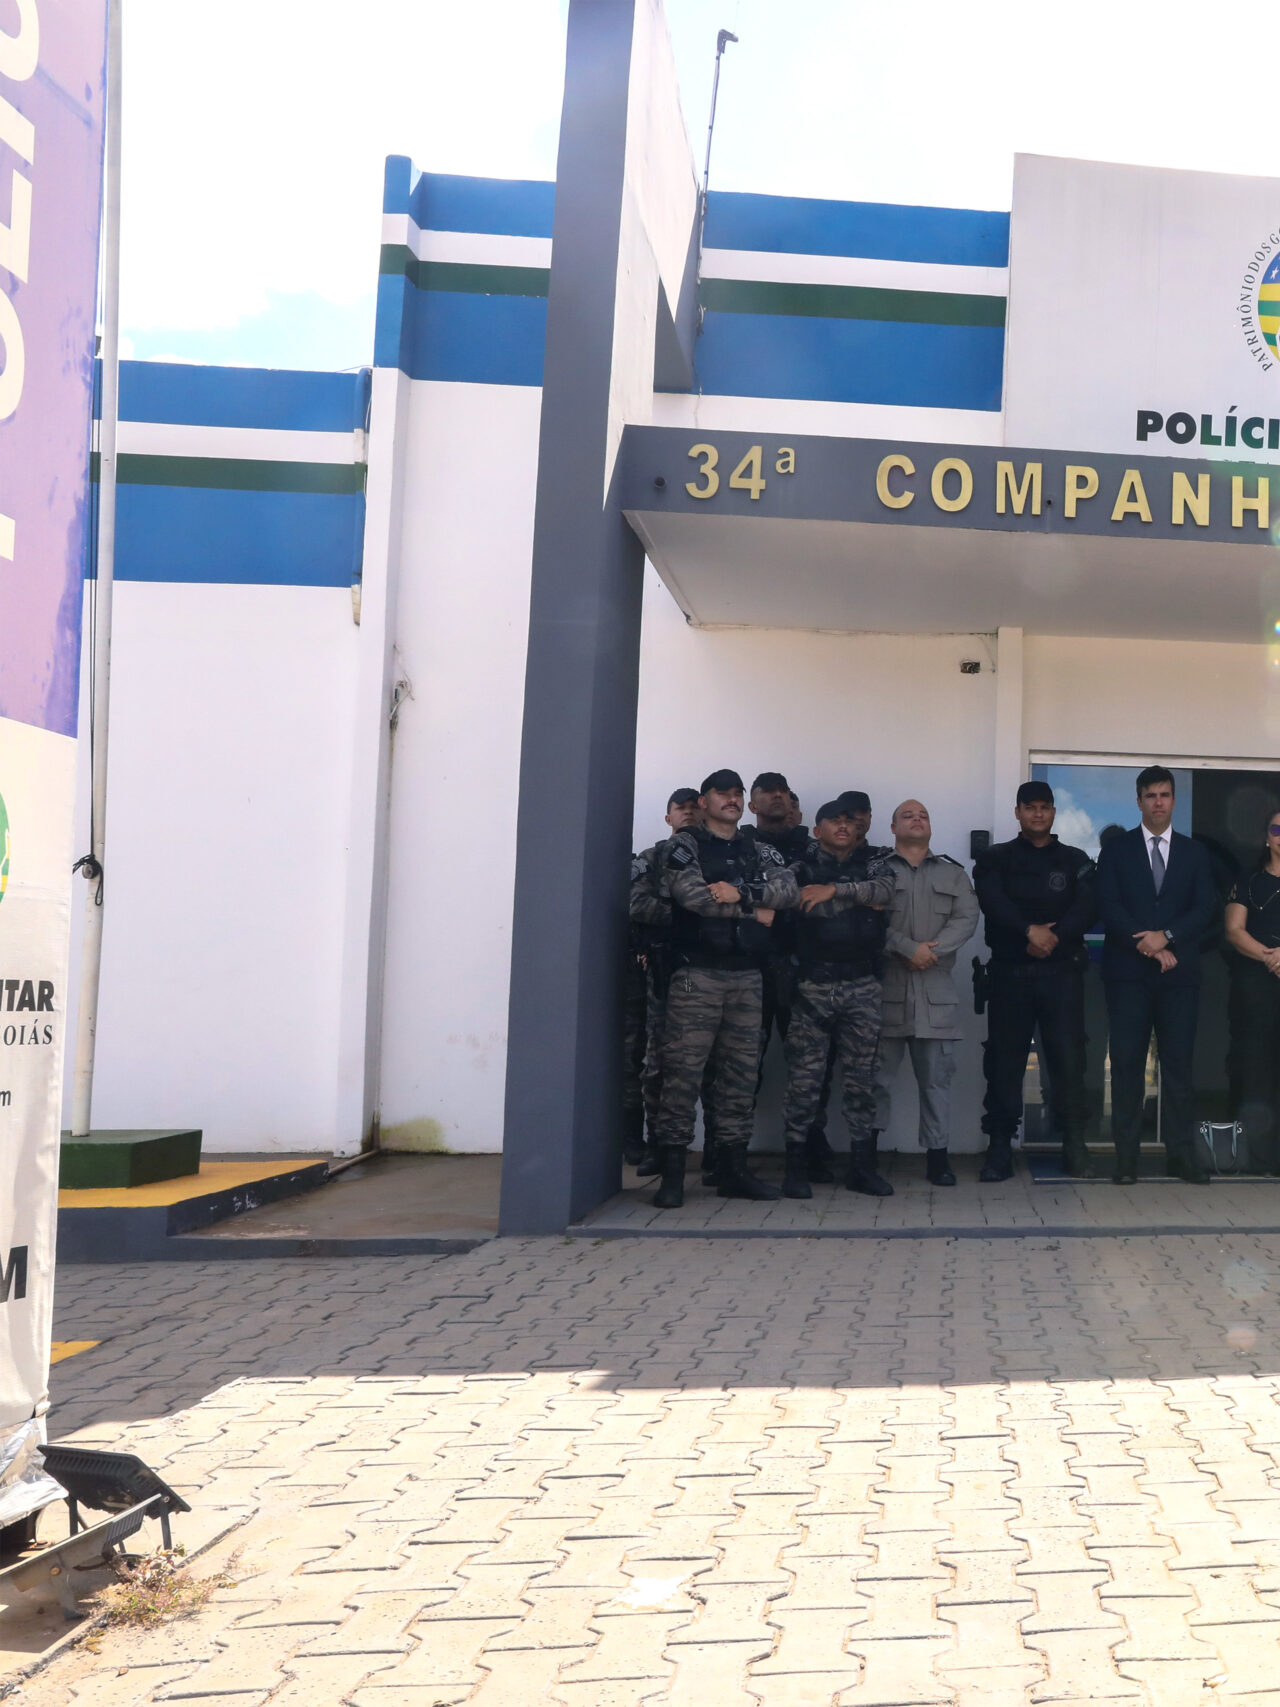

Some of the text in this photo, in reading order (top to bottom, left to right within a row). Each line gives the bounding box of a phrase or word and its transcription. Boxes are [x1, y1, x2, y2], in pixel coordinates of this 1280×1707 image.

[1248, 242, 1272, 274] DOS
[1236, 274, 1273, 372] PATRIMÔNIO
[0, 1018, 53, 1046] OIÁS
